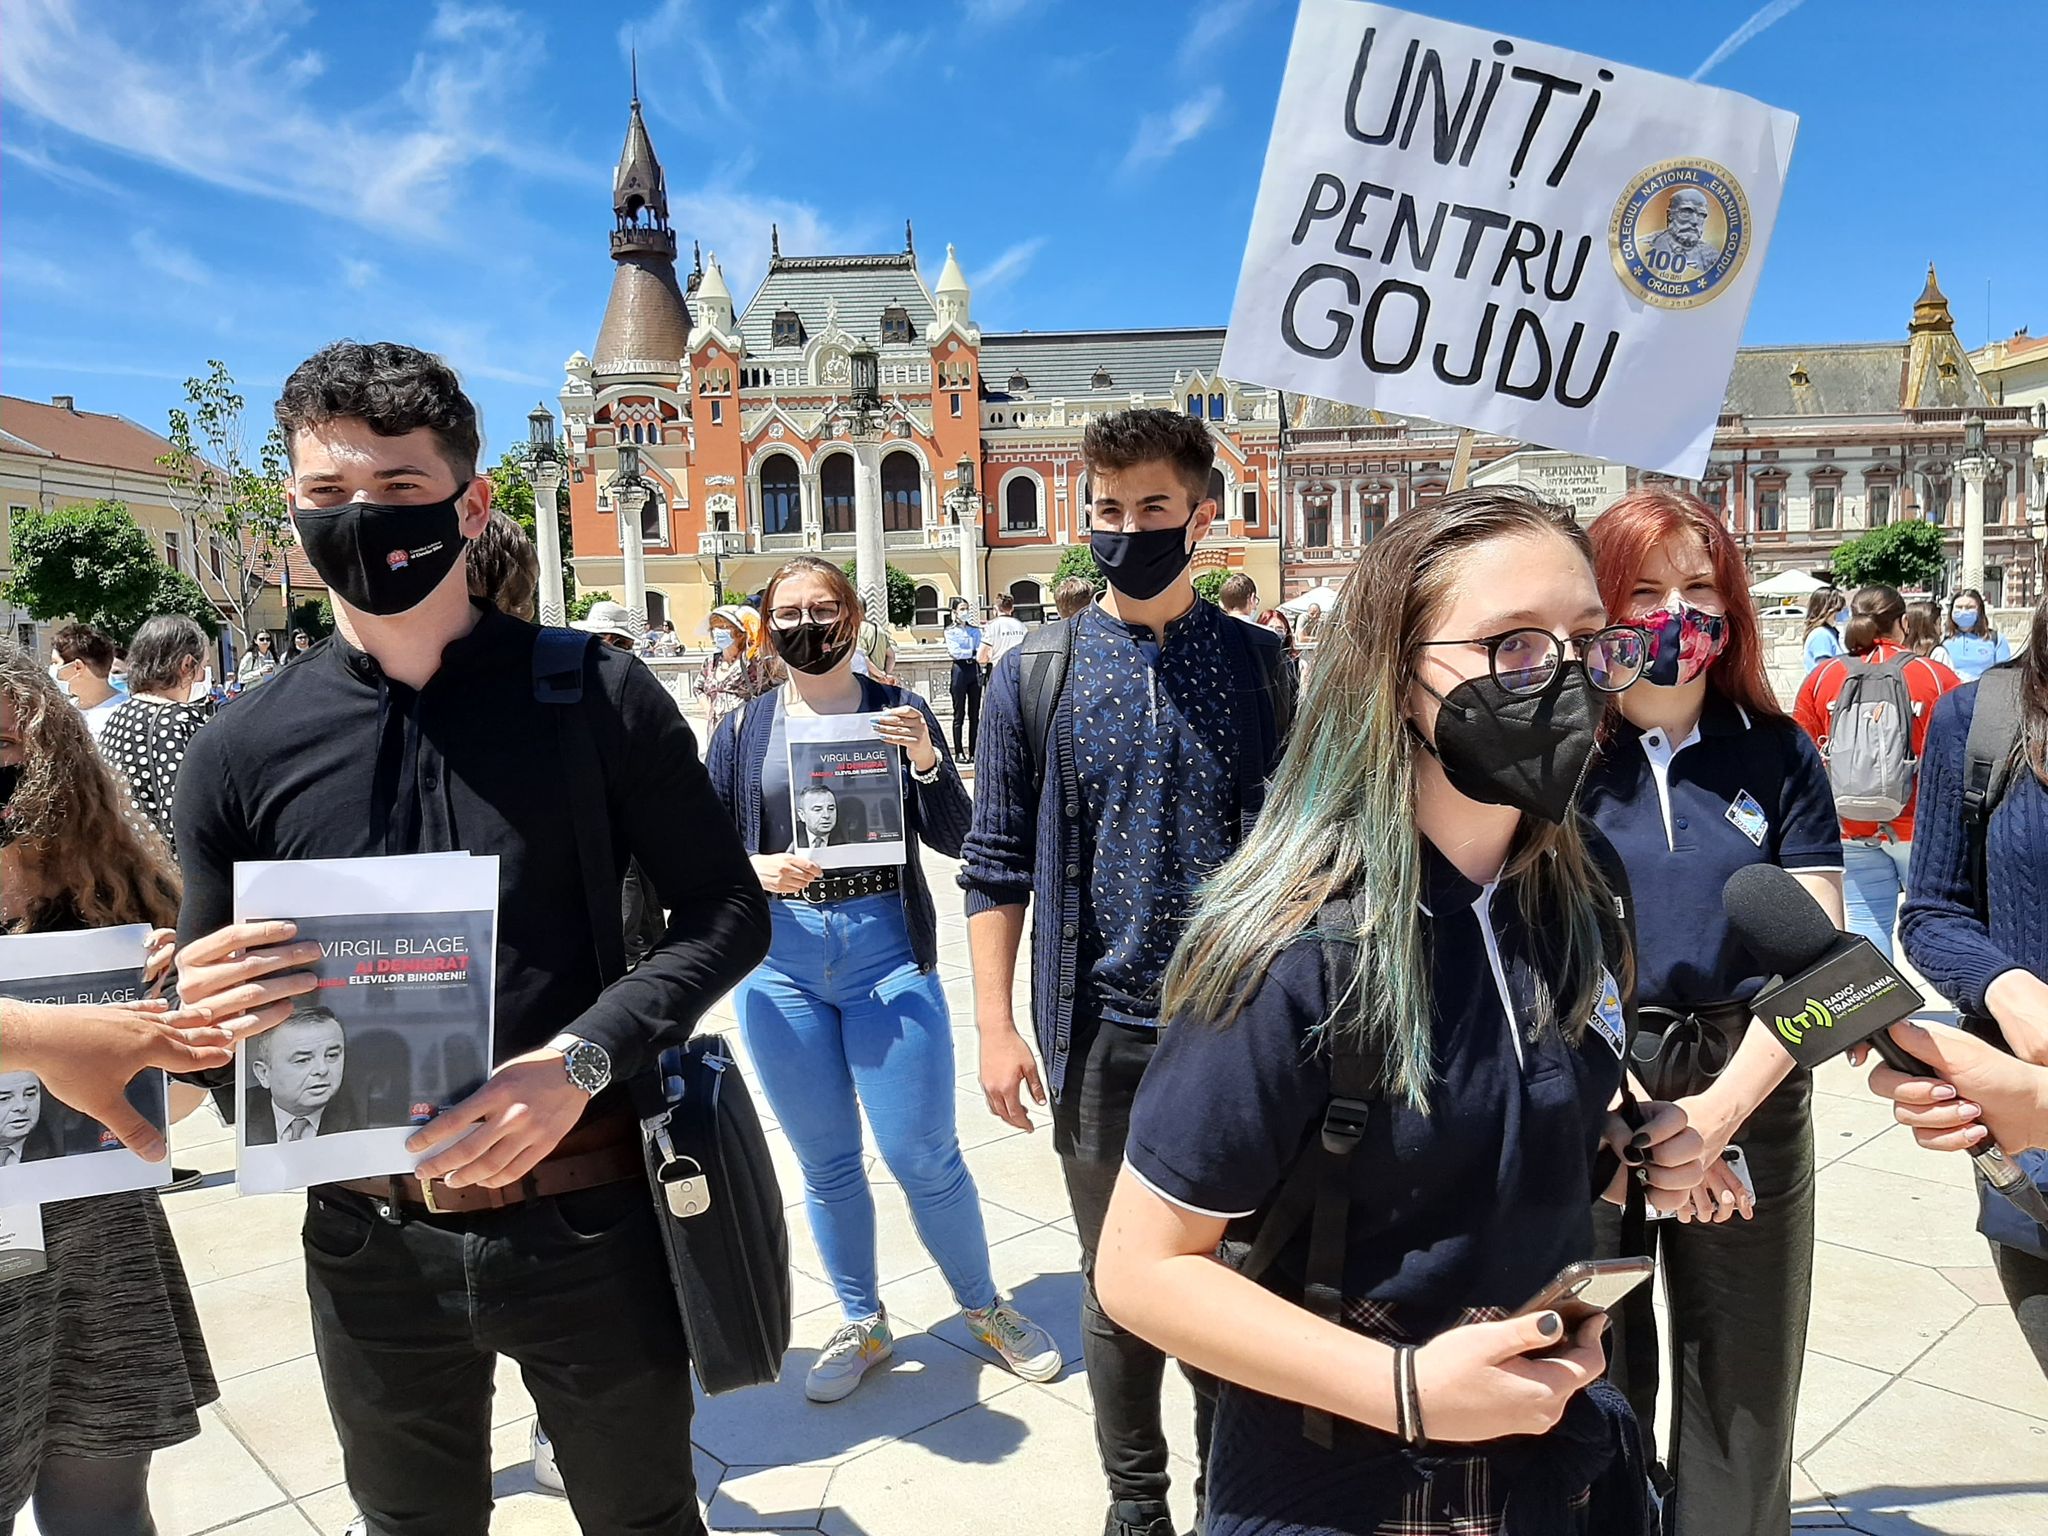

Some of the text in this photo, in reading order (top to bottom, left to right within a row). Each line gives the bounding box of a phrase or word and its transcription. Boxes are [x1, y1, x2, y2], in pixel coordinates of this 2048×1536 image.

[1291, 173, 1591, 302] PENTRU
[1622, 200, 1642, 260] COLEGIUL
[1645, 248, 1687, 274] 100
[1647, 278, 1690, 295] ORADEA
[1281, 263, 1619, 409] GOJDU
[1540, 465, 1598, 477] FERDINAND
[820, 753, 851, 763] VIRGIL
[318, 936, 469, 958] VIRGIL BLAGE,
[355, 956, 470, 974] AI DENIGRAT
[349, 974, 405, 985] ELEVILOR
[407, 971, 467, 982] BIHORENI!
[1822, 985, 1854, 1008] RADIO
[1828, 975, 1896, 1015] TRANSILVANIA
